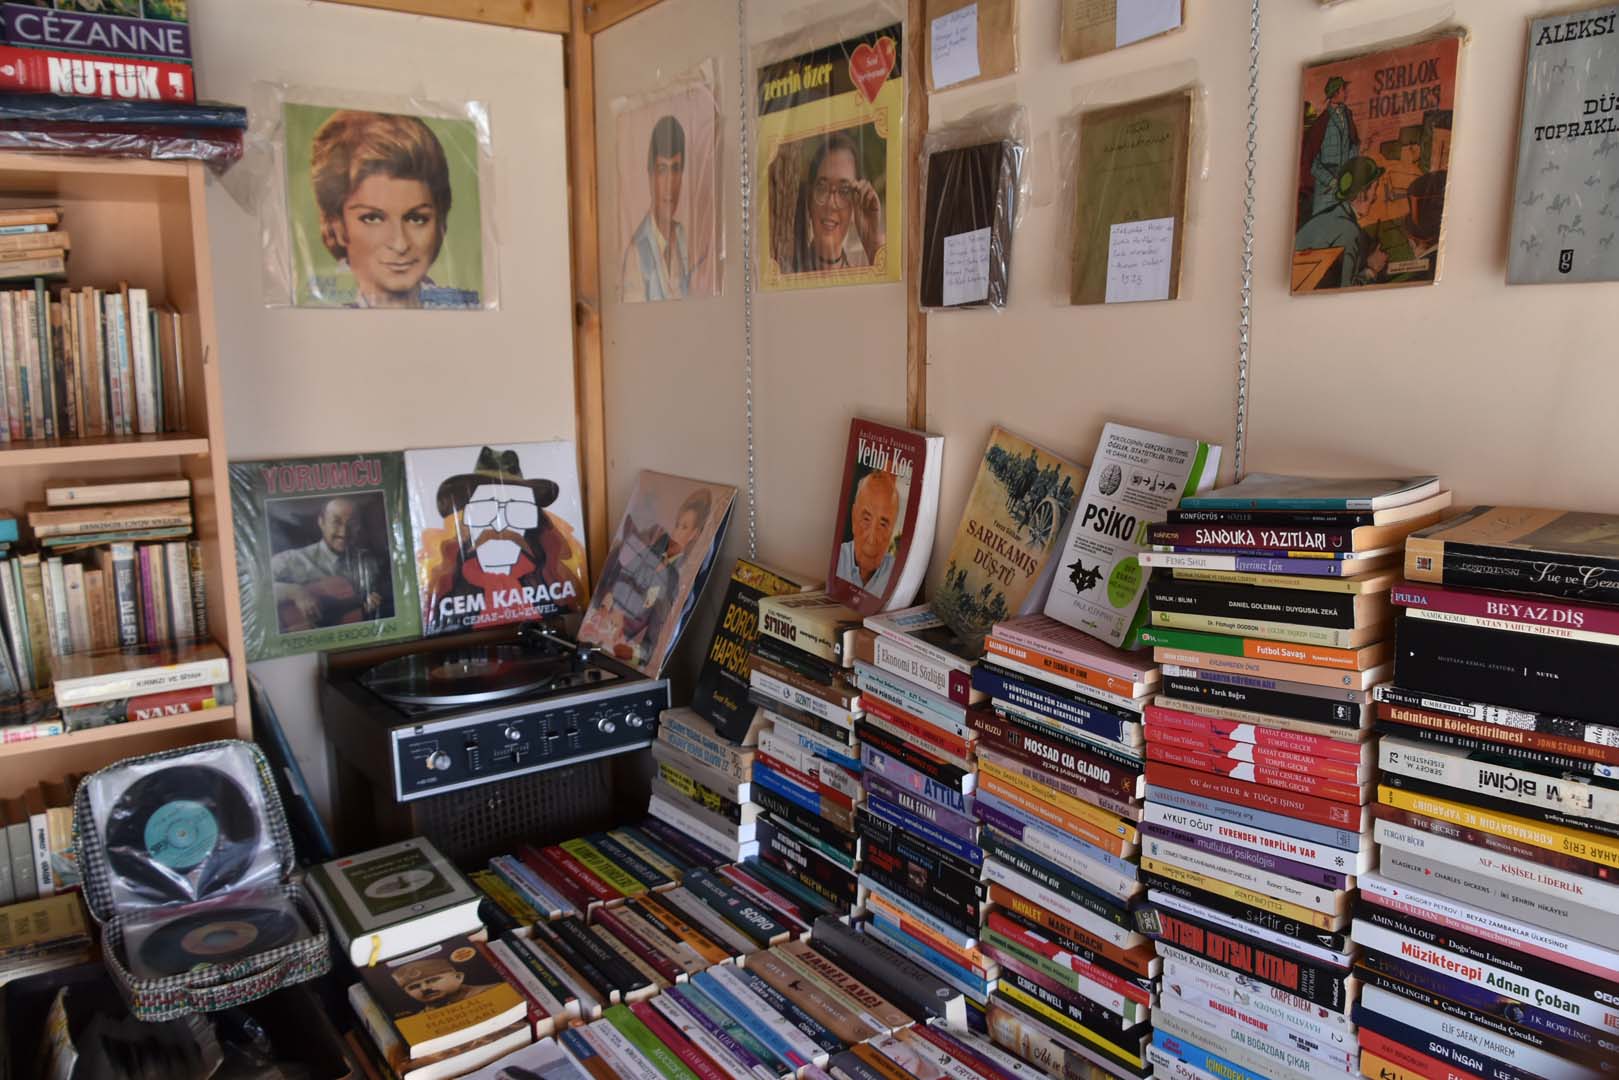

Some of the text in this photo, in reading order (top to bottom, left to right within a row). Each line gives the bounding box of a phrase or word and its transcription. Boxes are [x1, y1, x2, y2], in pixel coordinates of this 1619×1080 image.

[15, 13, 184, 54] CÉZANNE
[48, 57, 161, 99] NUTUK
[858, 438, 890, 472] Vehbi
[1261, 531, 1326, 550] YAZITLARI
[440, 581, 576, 617] CEM KARACA
[1229, 601, 1250, 609] DANIEL
[1286, 605, 1319, 615] DUYGUSAL
[1487, 601, 1584, 628] BEYAZ DİŞ
[1257, 646, 1280, 655] Futbol
[1536, 670, 1560, 679] NUTUK
[135, 702, 191, 721] NANA
[1423, 701, 1472, 714] UMBERTO ECO
[984, 723, 1001, 736] KUZU
[1390, 708, 1443, 728] Kadınların
[1444, 719, 1524, 744] Köleleştirilmesi
[1537, 739, 1557, 749] JOHN
[1558, 742, 1586, 754] STUART
[1024, 737, 1059, 762] MOSSAD
[1061, 752, 1075, 769] CIA
[1077, 760, 1111, 784] GLADIO
[1389, 751, 1399, 764] 73
[1163, 812, 1187, 824] AYKUT
[1219, 826, 1257, 843] EVRENDEN
[1300, 847, 1316, 858] VAR
[1412, 817, 1461, 838] THE SECRET
[1197, 839, 1233, 855] mutluluk
[1434, 871, 1461, 885] CHARLES
[1463, 880, 1490, 894] DICKENS
[1399, 921, 1436, 942] MAALOUF
[1466, 913, 1487, 925] BEYAZ
[1488, 919, 1529, 937] ZAMBAKLAR
[1401, 942, 1482, 981] Müzikterapi
[1486, 971, 1530, 997] Adnan
[1535, 988, 1581, 1016] Çoban
[1270, 988, 1292, 1005] CARPE
[1231, 1028, 1245, 1042] CAN
[1428, 1041, 1483, 1072] SON İNSAN
[1484, 1037, 1515, 1057] MAHREM
